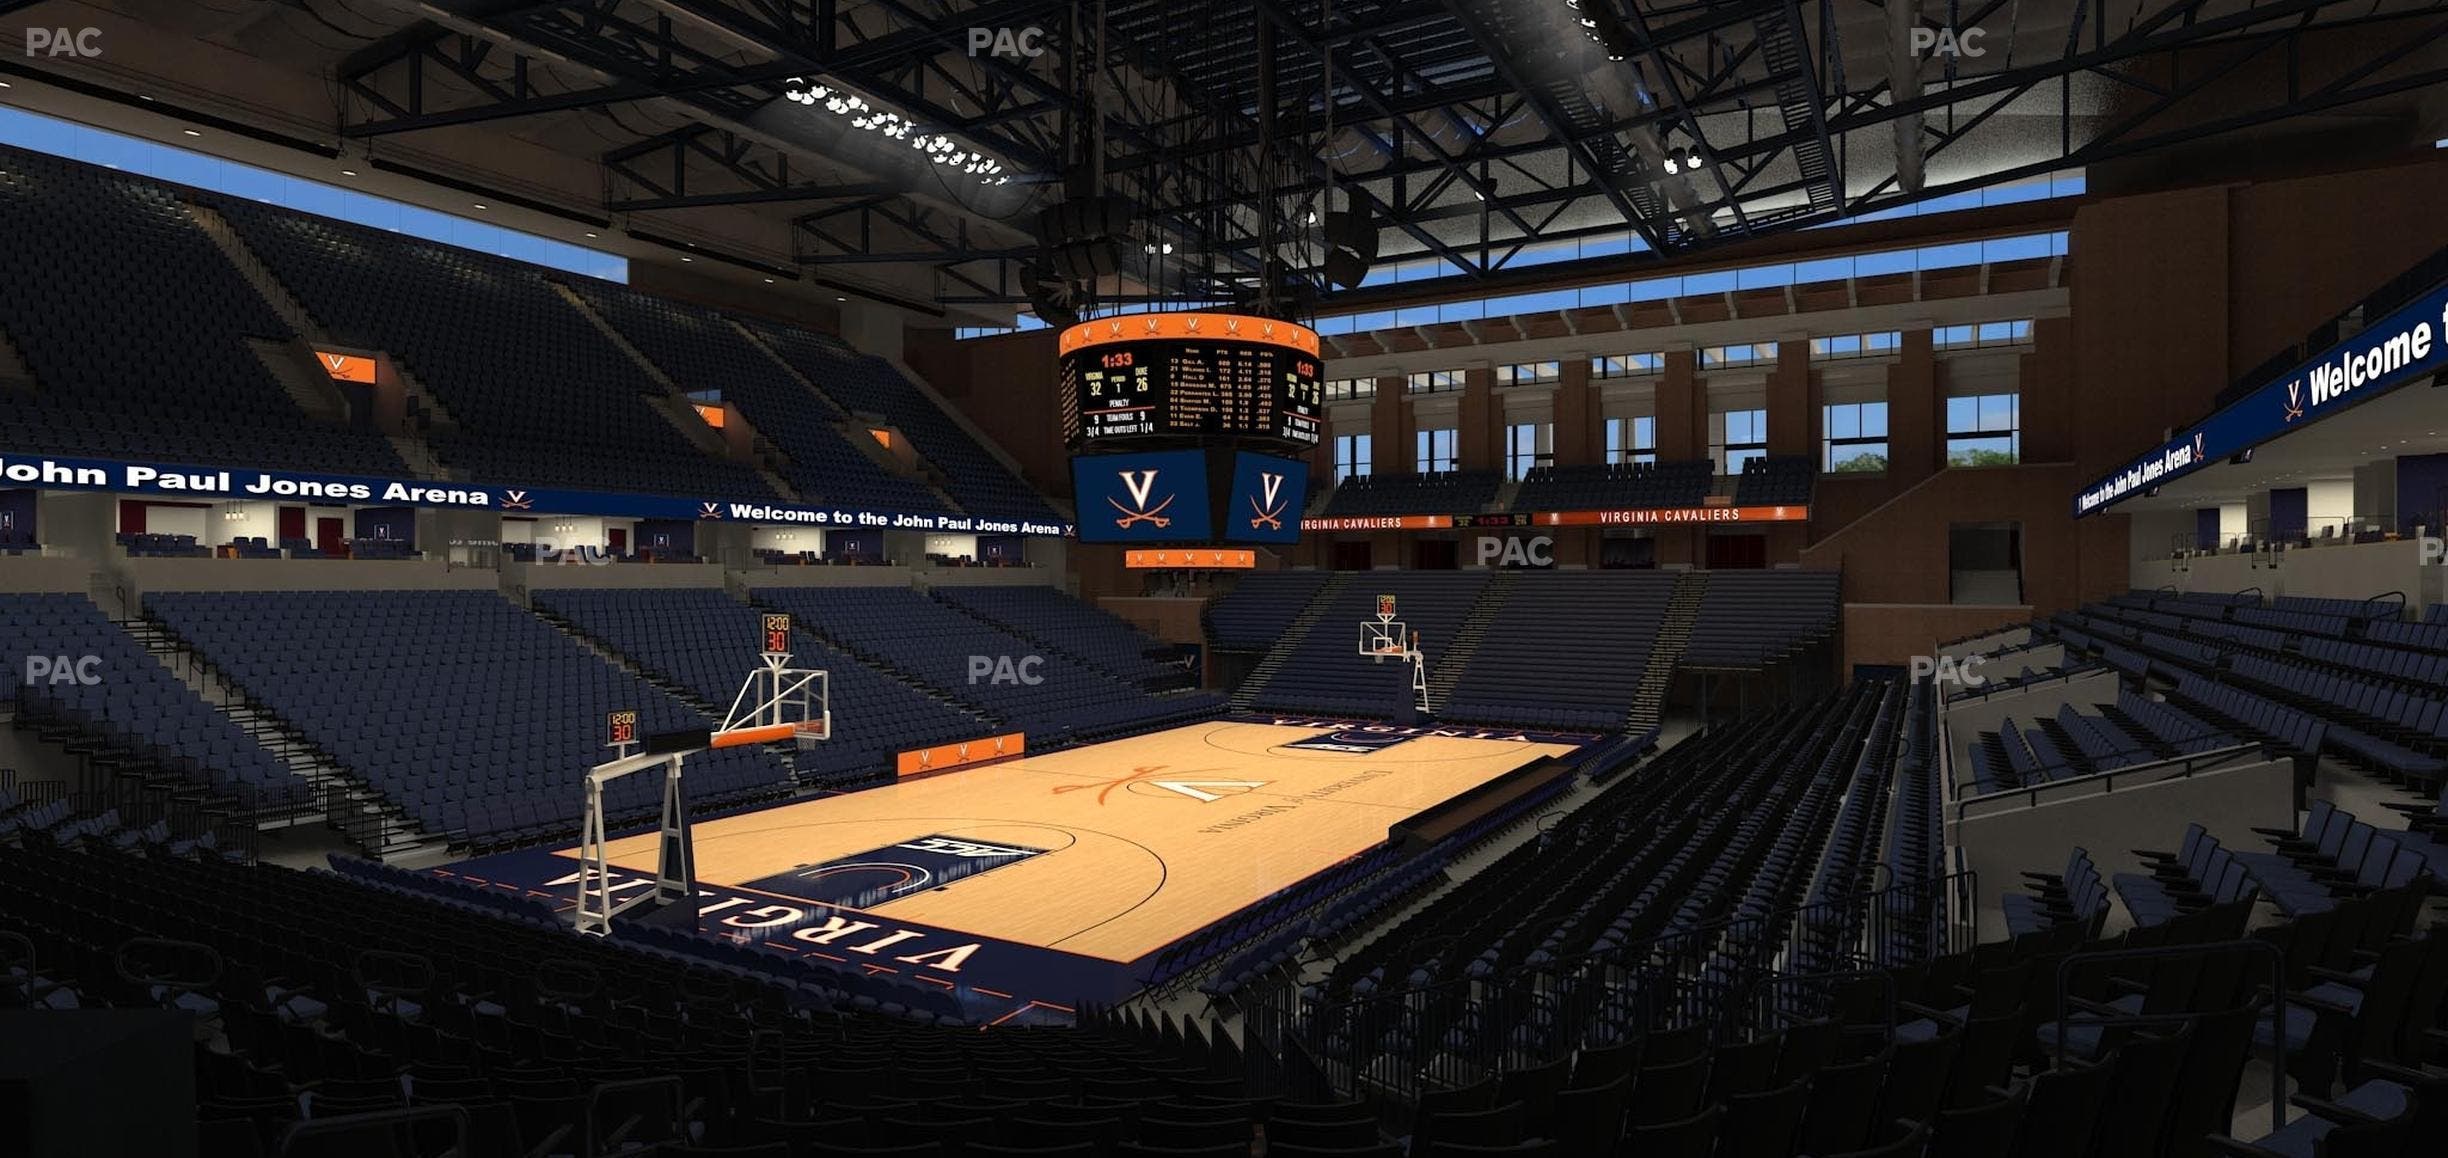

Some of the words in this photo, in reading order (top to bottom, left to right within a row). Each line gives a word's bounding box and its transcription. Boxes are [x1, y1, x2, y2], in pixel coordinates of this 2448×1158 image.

[1101, 352, 1134, 368] 1:33
[2310, 322, 2431, 405] Welcome
[1297, 361, 1313, 377] 1:33
[1090, 381, 1102, 396] 32
[1116, 382, 1121, 393] 1
[1136, 377, 1149, 392] 26
[2286, 378, 2301, 408] V
[1093, 414, 1100, 425] 9
[1086, 426, 1099, 438] 3/4
[1140, 422, 1153, 434] 1/4
[2114, 474, 2127, 497] John
[2127, 464, 2142, 491] Paul
[2142, 458, 2164, 485] Jones
[2164, 444, 2191, 474] Arena
[0, 459, 105, 484] ohn
[127, 467, 229, 491] Paul
[246, 475, 370, 498] Jones
[383, 483, 488, 504] Arena
[1119, 470, 1159, 513] V
[1262, 472, 1285, 513] V
[731, 504, 827, 522] Welcome
[833, 511, 852, 523] to
[858, 512, 887, 525] the
[893, 515, 932, 527] John
[939, 517, 971, 529] Paul
[976, 520, 1017, 532] Jones
[1022, 522, 1059, 534] Arena
[1301, 520, 1338, 529] IRGINIA
[1344, 518, 1400, 528] CAVALIERS
[1601, 512, 1657, 522] VIRGINIA
[1665, 509, 1738, 521] CAVALIERS
[766, 616, 790, 631] 12:00
[768, 632, 785, 652] 30
[612, 713, 635, 725] 12:00
[614, 725, 631, 741] 30
[1274, 719, 1529, 741] VIRGINIA
[543, 868, 982, 973] VIRGIIA
